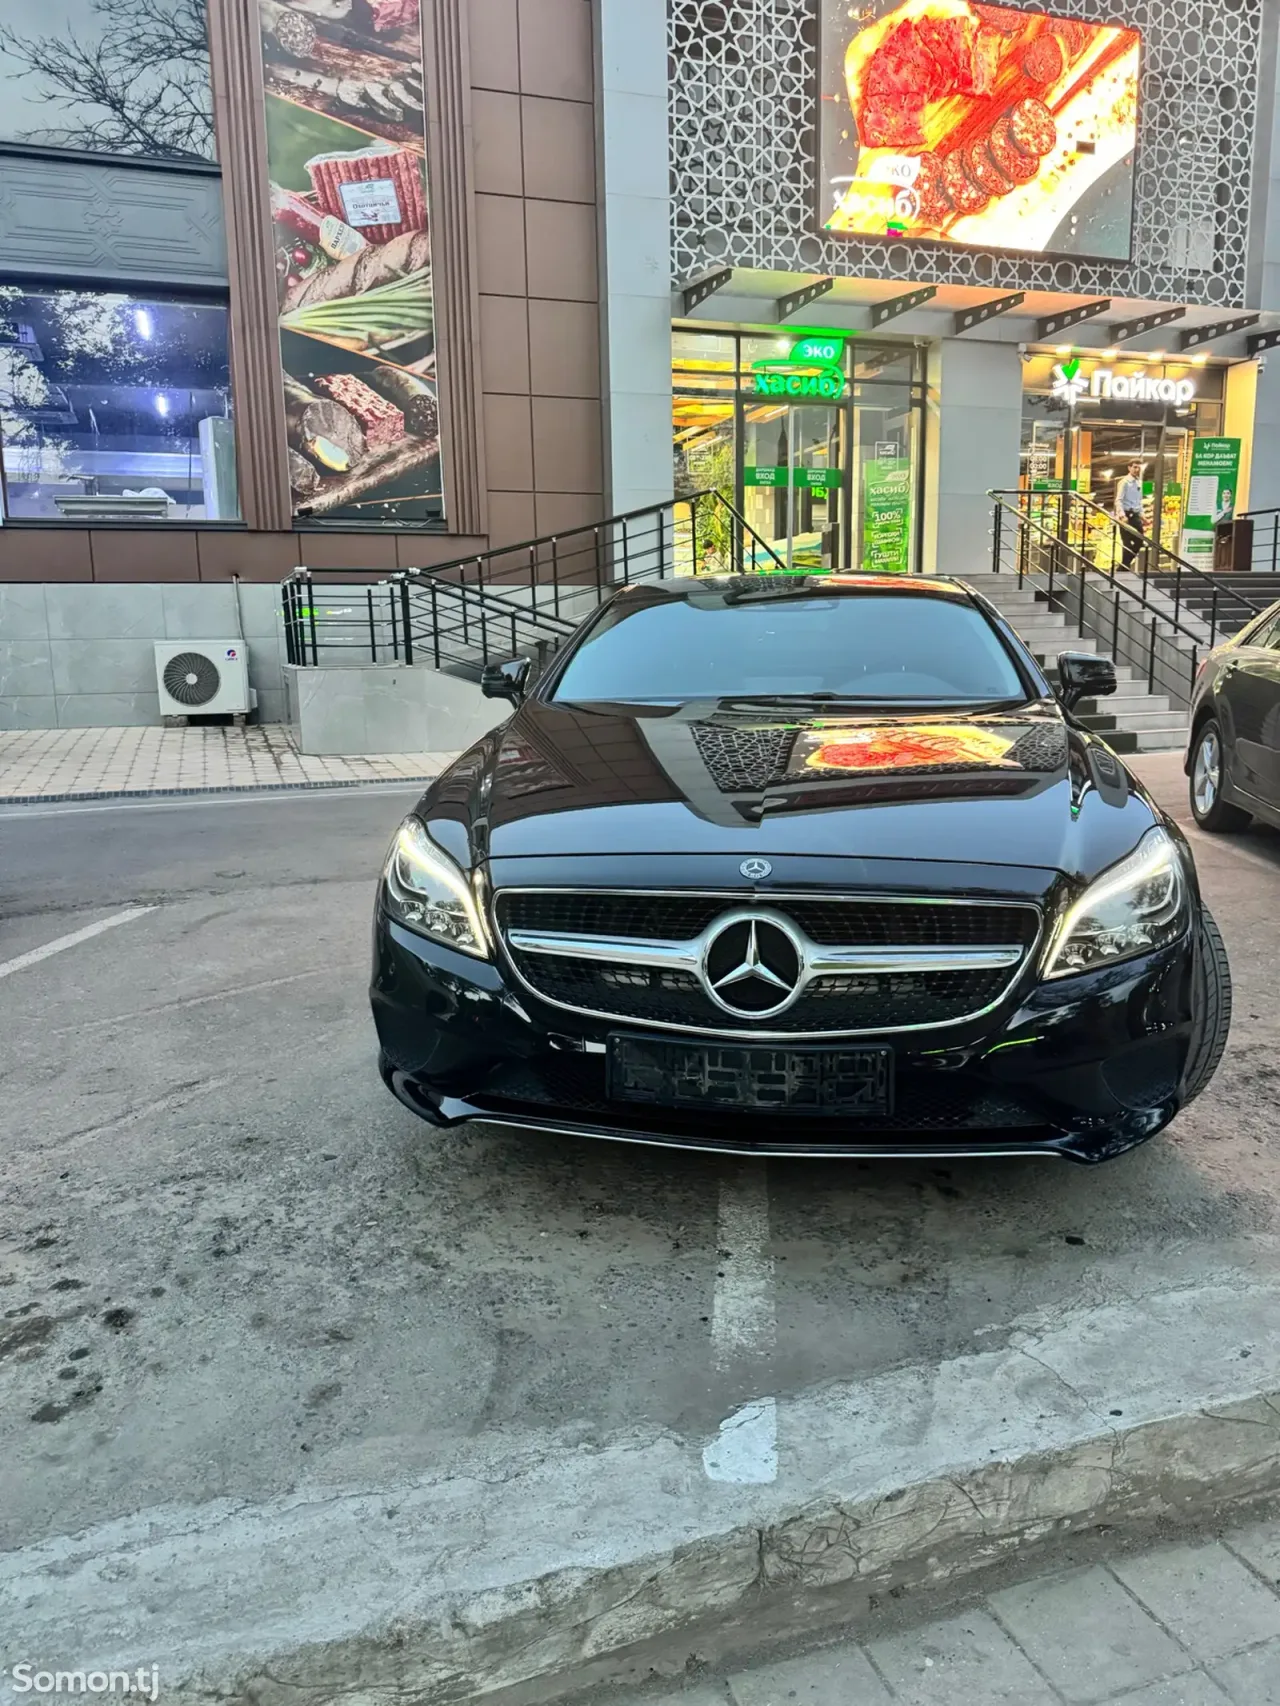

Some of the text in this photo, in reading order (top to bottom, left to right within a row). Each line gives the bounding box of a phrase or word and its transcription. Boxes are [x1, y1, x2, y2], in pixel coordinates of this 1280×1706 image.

[754, 369, 836, 398] хасиб
[1089, 369, 1195, 406] Пайкар
[755, 472, 776, 481] ВХОД
[806, 473, 827, 482] ВХОД
[874, 509, 902, 522] 100%
